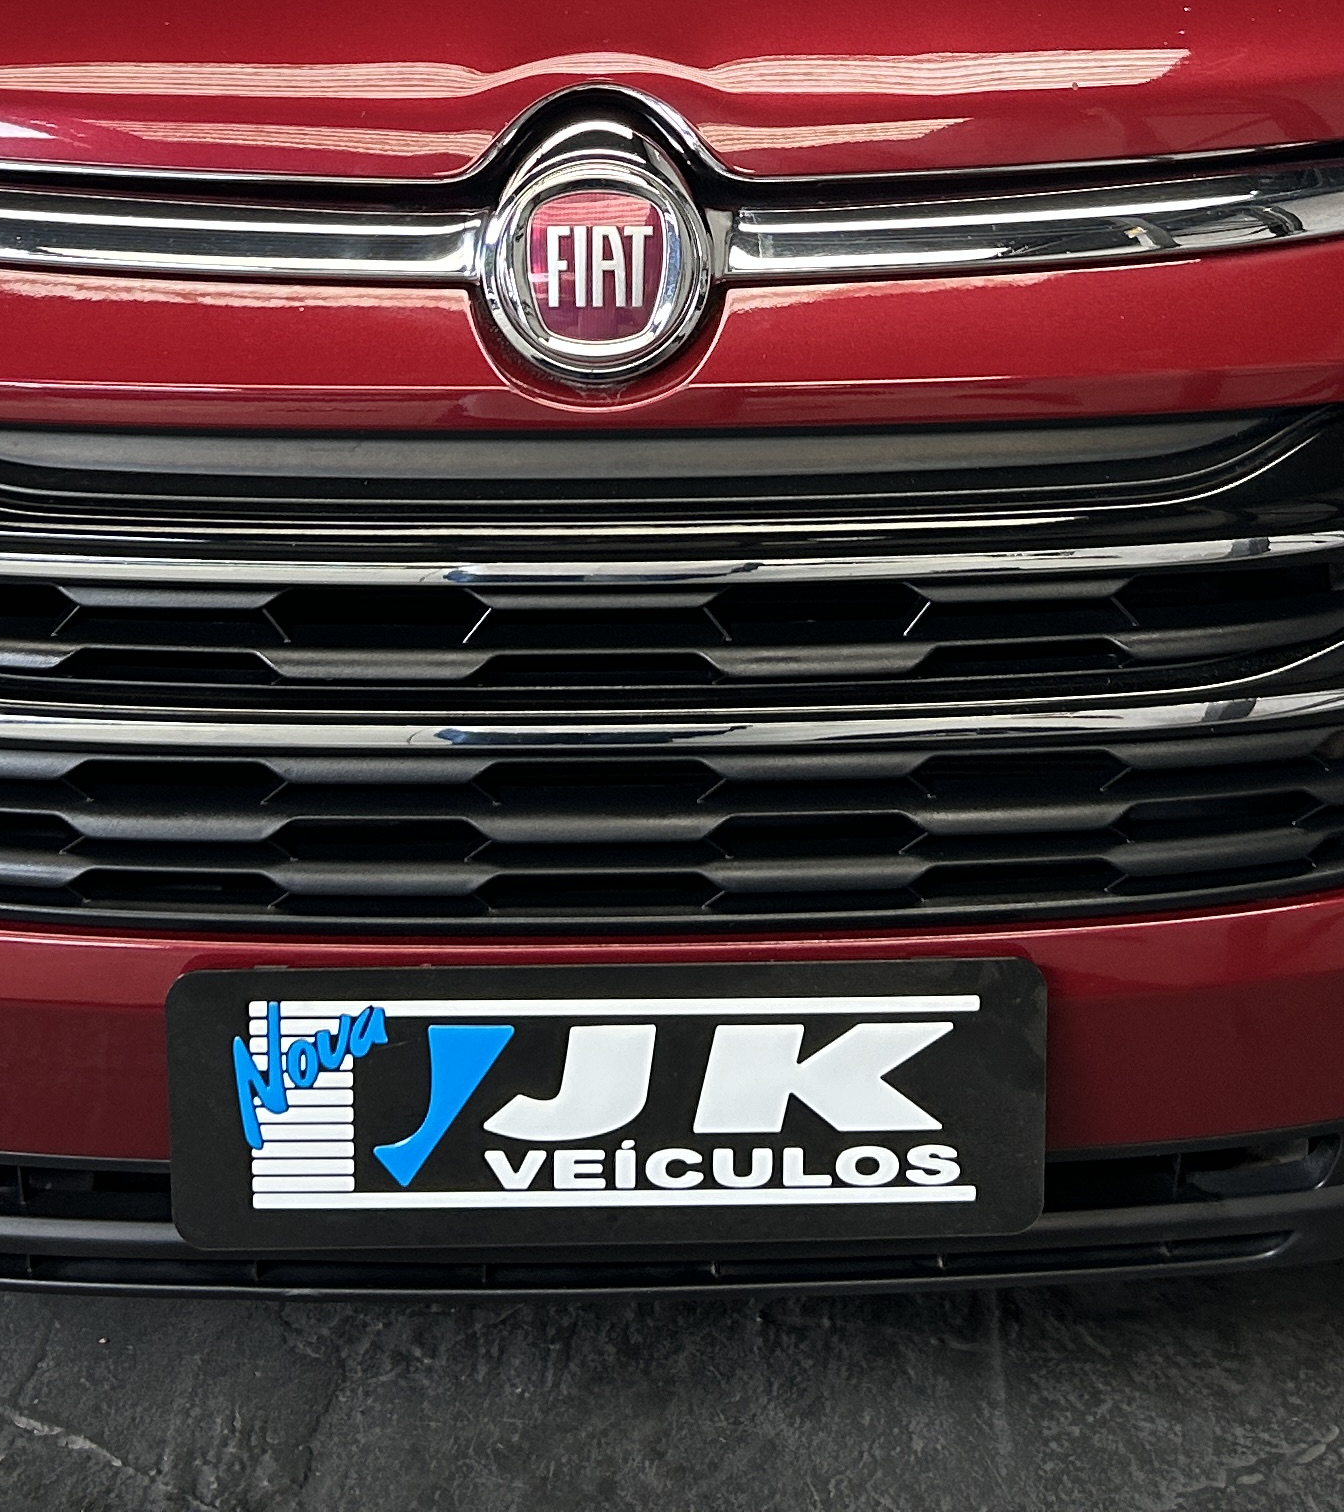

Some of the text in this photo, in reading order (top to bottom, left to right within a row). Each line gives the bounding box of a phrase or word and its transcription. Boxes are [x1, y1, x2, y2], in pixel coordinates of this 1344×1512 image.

[546, 225, 654, 308] FIAT
[233, 1001, 954, 1149] Nova JK
[484, 1140, 961, 1190] VEÍCULOS
